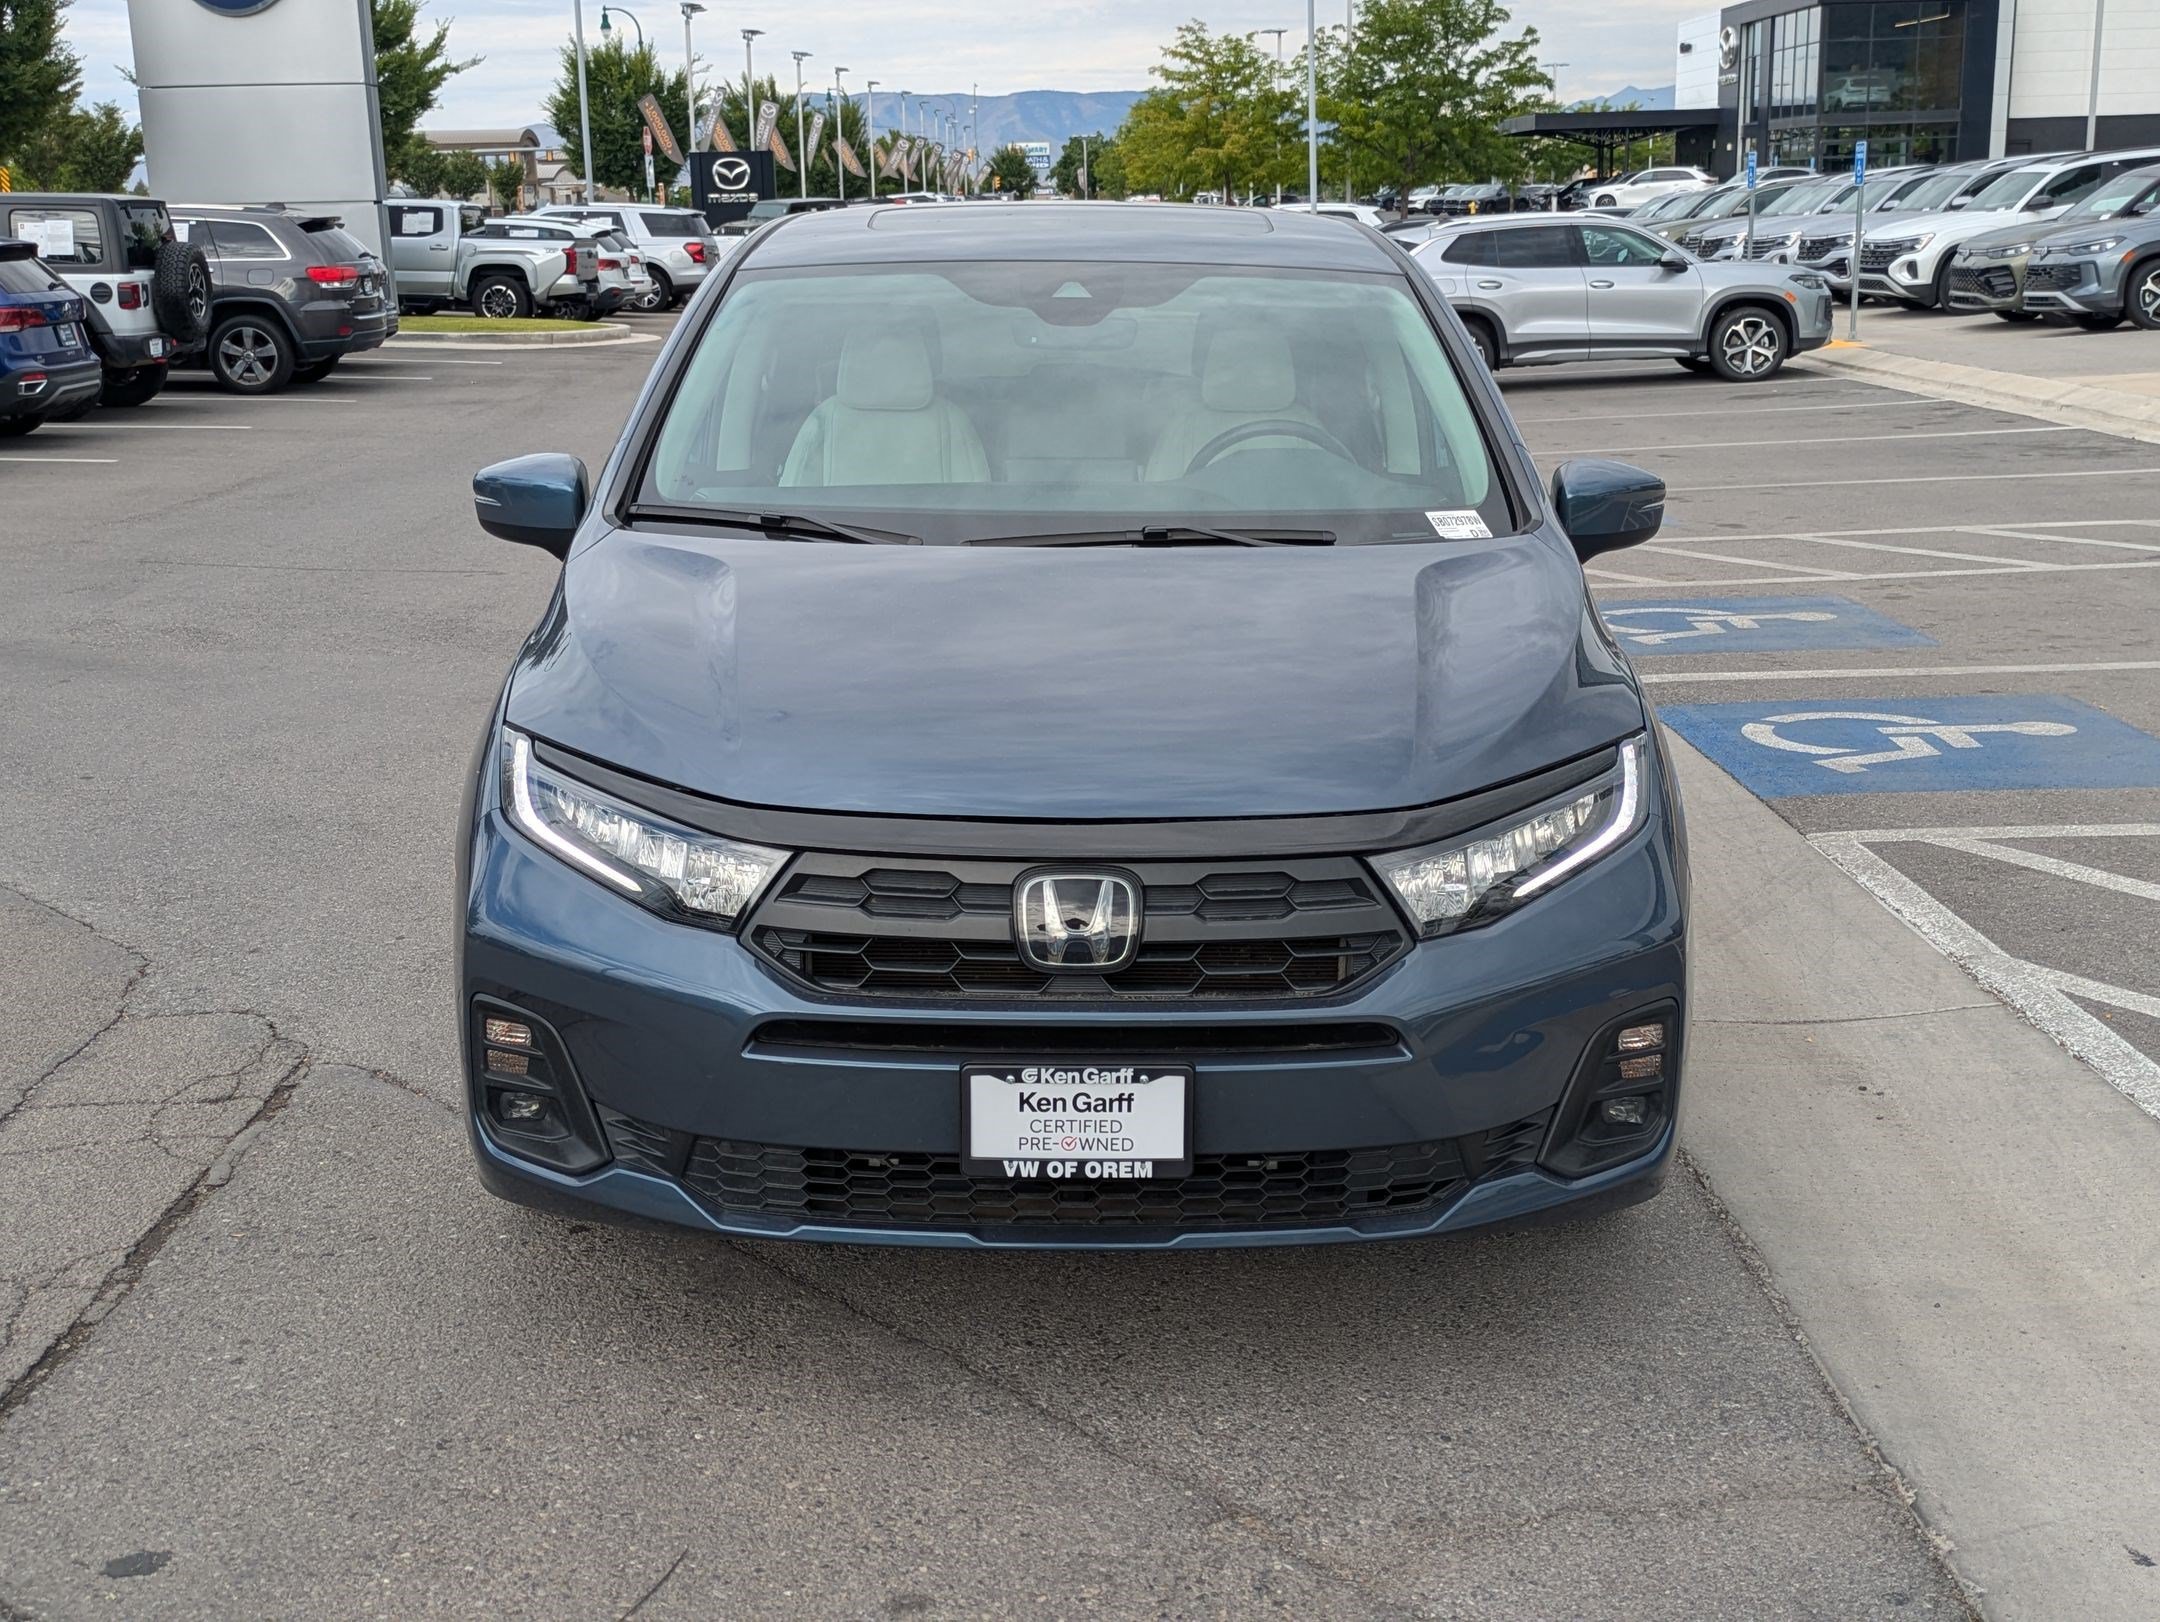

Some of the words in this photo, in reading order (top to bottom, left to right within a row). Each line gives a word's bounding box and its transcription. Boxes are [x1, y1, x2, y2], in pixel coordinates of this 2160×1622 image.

[1019, 1092, 1067, 1113] Ken
[1072, 1092, 1135, 1113] Garff
[1030, 1119, 1123, 1133] CERTIFIED
[1003, 1161, 1039, 1178] VW
[1047, 1161, 1078, 1178] OF
[1084, 1161, 1153, 1178] OREM
